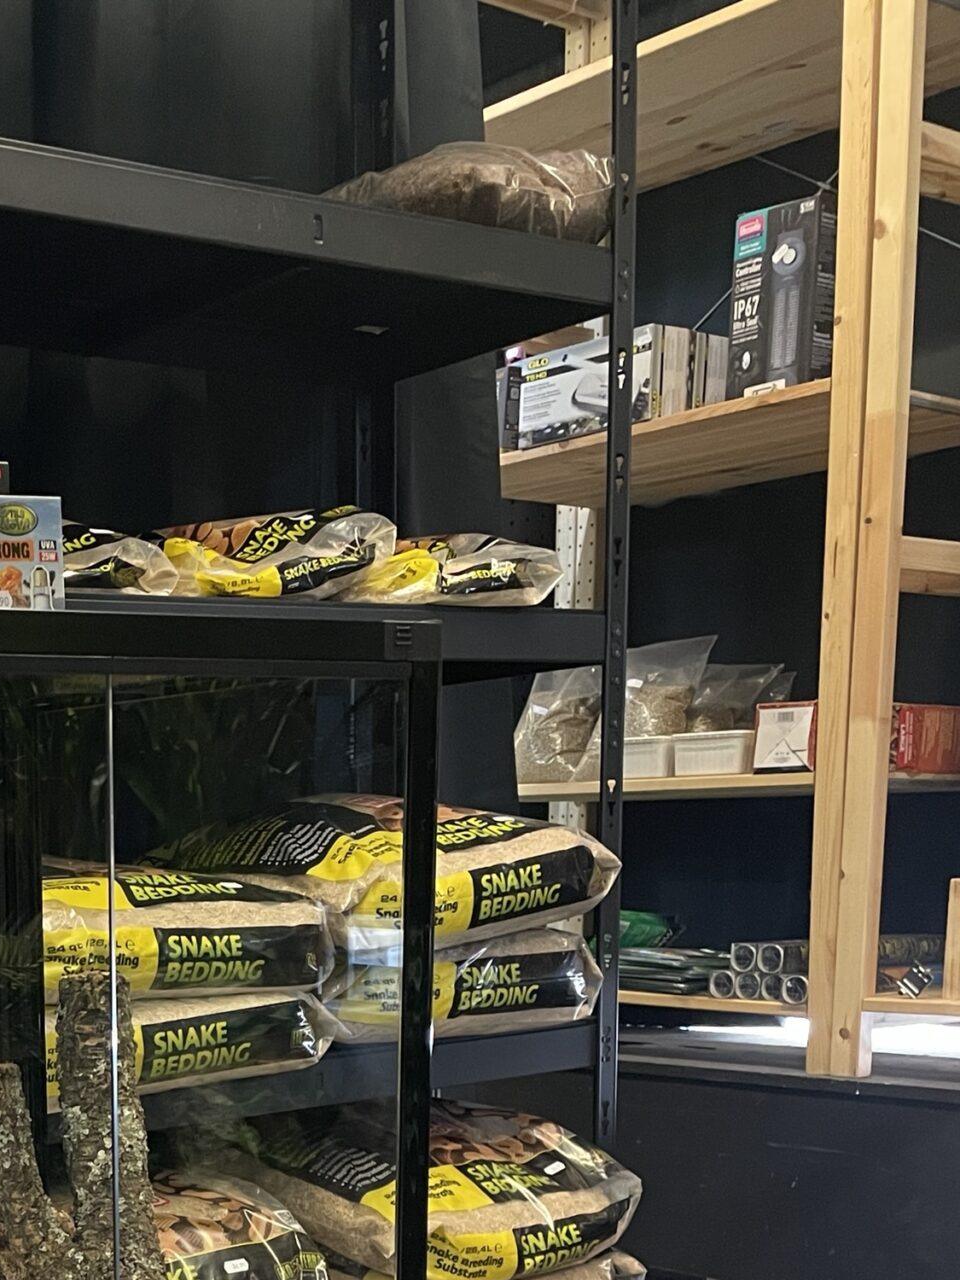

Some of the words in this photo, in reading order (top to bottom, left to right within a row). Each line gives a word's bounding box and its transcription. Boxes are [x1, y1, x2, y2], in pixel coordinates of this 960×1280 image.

[734, 295, 759, 320] IP67
[528, 357, 549, 370] GLO
[437, 814, 487, 834] NAKE
[481, 863, 542, 897] SNAKE
[479, 883, 561, 920] BEDDING
[167, 933, 243, 960] SNAKE
[164, 959, 266, 984] BEDDING
[462, 963, 522, 988] SNAKE
[458, 984, 540, 1012] BEDDING
[153, 1021, 229, 1054] SNAKE
[149, 1042, 253, 1079] BEDDING
[521, 1223, 583, 1256] SNAKE
[434, 1258, 488, 1279] Substrate
